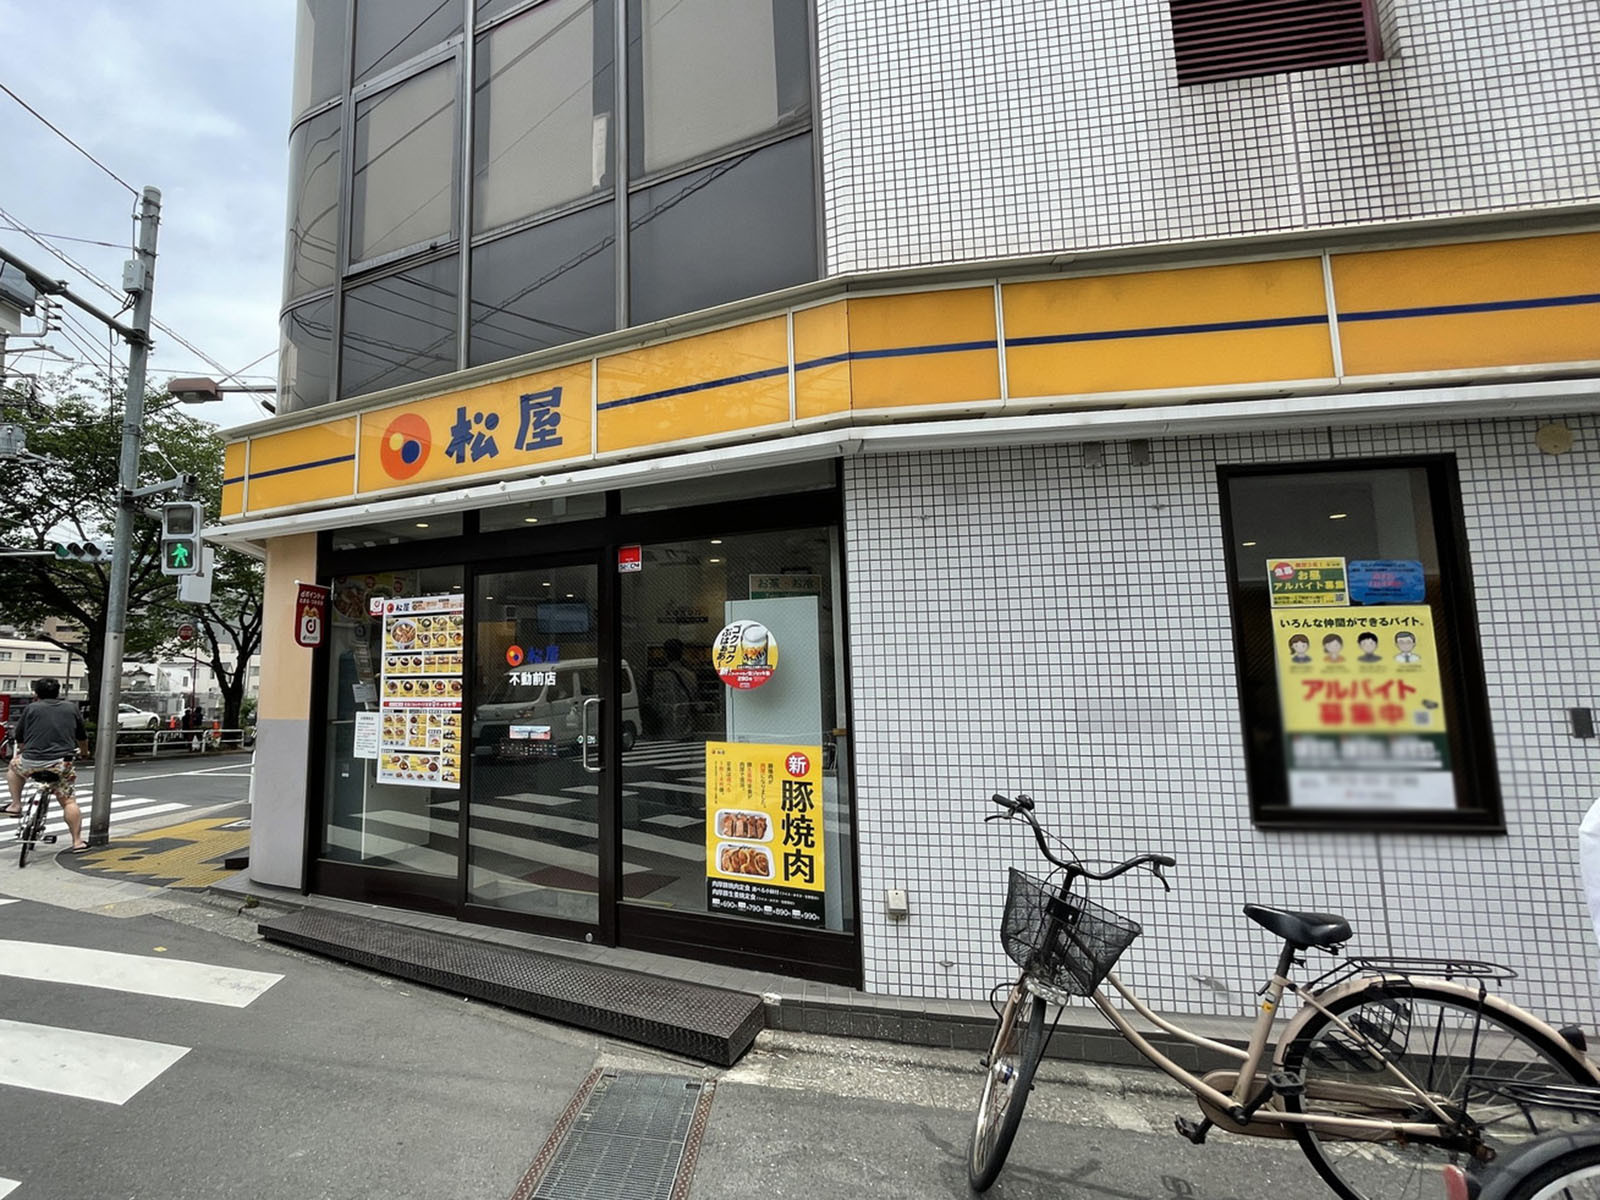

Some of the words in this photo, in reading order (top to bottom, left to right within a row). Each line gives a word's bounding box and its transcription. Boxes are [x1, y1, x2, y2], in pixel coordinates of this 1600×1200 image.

[445, 386, 563, 464] 松屋
[526, 643, 561, 664] 松屋
[508, 672, 557, 686] 不動前店
[1302, 679, 1417, 700] アルバイト
[788, 755, 807, 774] 新
[781, 780, 815, 884] 豚焼肉
